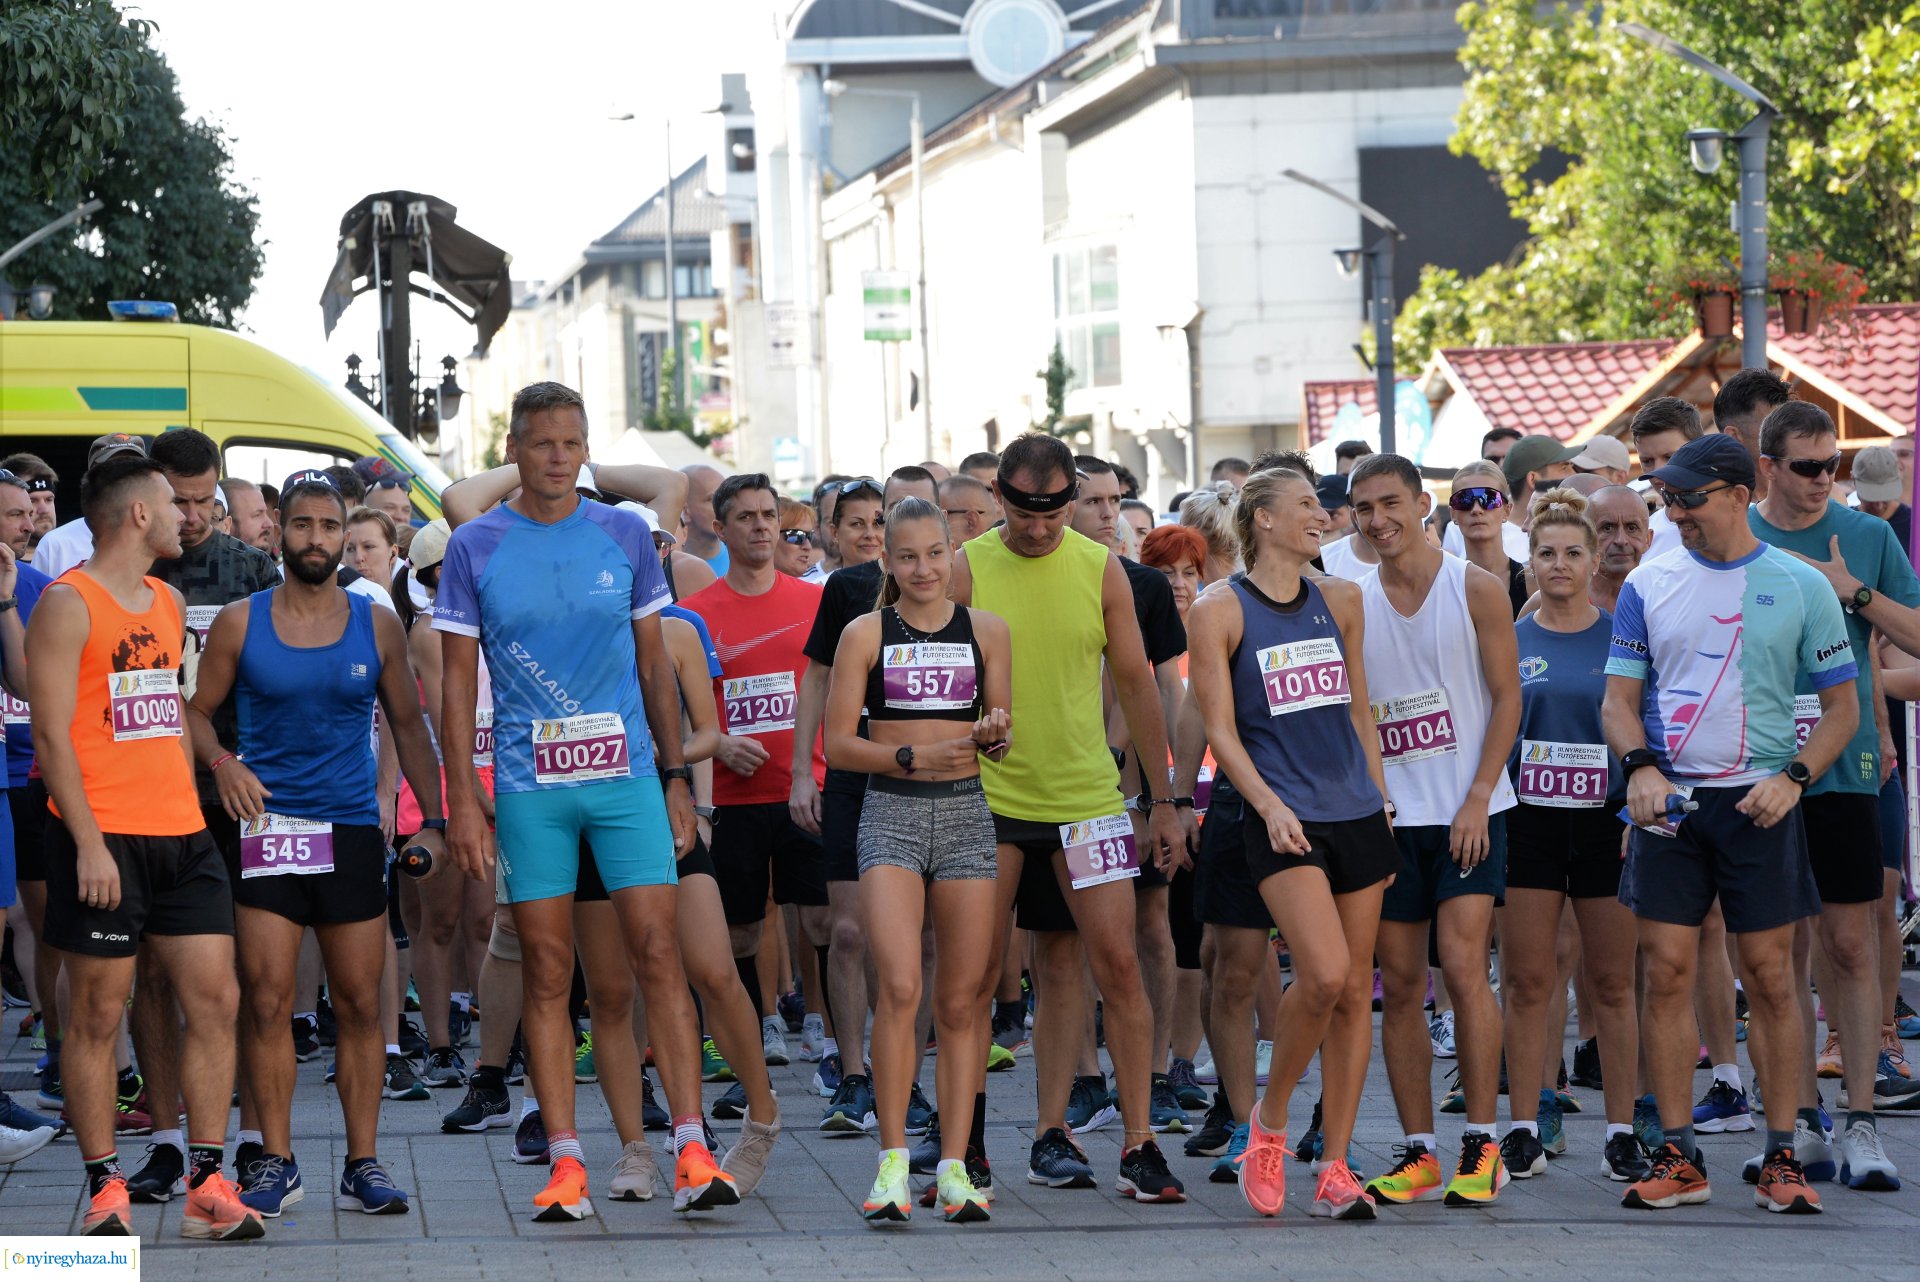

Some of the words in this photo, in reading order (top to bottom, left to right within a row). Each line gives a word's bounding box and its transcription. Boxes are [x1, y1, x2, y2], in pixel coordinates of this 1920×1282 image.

[293, 472, 331, 486] FILA
[453, 610, 466, 618] SE
[1296, 648, 1336, 658] FUTÓFESZTIVÁL
[907, 670, 955, 695] 557
[1269, 666, 1343, 700] 10167
[116, 698, 178, 727] 10009
[727, 693, 795, 722] 21207
[1395, 698, 1441, 713] FUTÓFESZTIVÁL
[570, 722, 617, 733] FUTÓFESZTIVÁL
[1378, 715, 1452, 752] 10104
[538, 739, 623, 770] 10027
[1557, 752, 1603, 760] FUTÓFESZTIVÁL
[953, 779, 977, 791] NIKE
[1524, 768, 1601, 795] 10181
[262, 837, 311, 862] 545
[1087, 839, 1128, 869] 538
